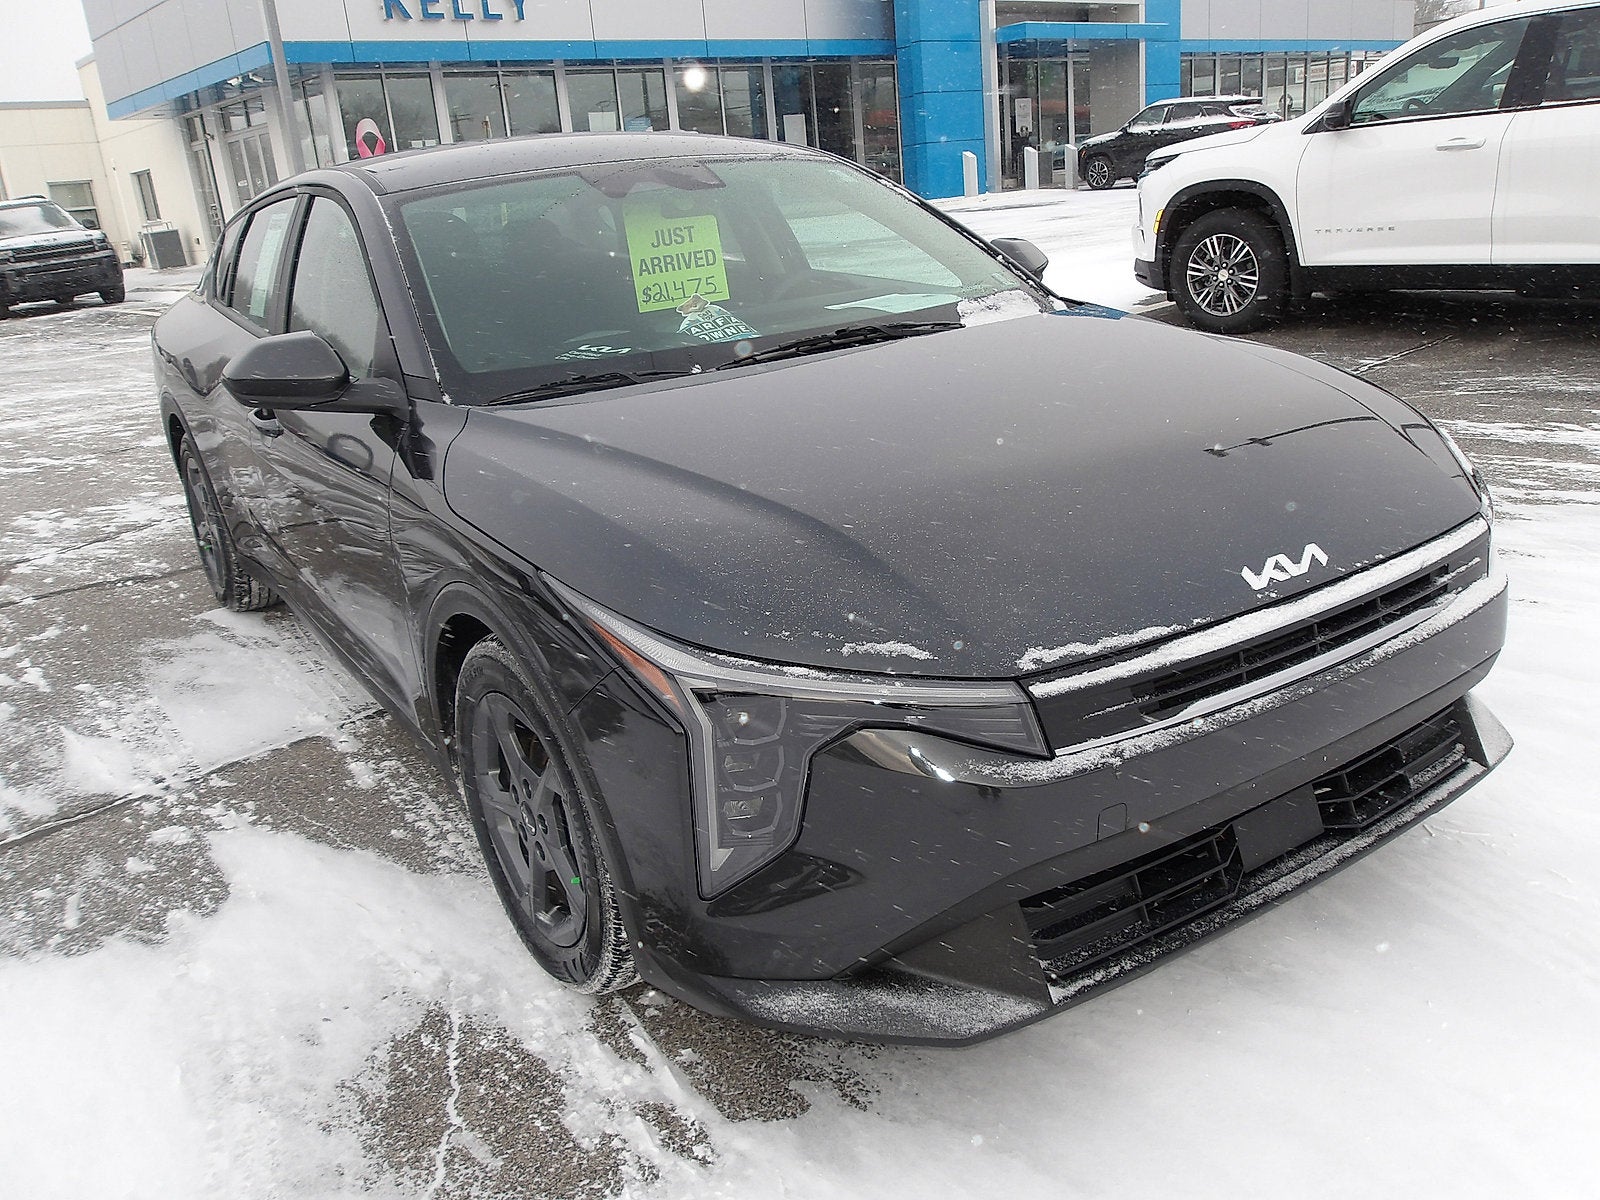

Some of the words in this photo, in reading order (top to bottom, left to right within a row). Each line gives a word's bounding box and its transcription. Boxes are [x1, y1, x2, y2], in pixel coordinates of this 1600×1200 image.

[383, 0, 525, 20] KELLY
[650, 226, 694, 248] JUST
[639, 248, 717, 276] ARRIVED
[642, 276, 718, 304] $21,475
[690, 316, 740, 334] ARFA
[1241, 542, 1328, 590] KIA
